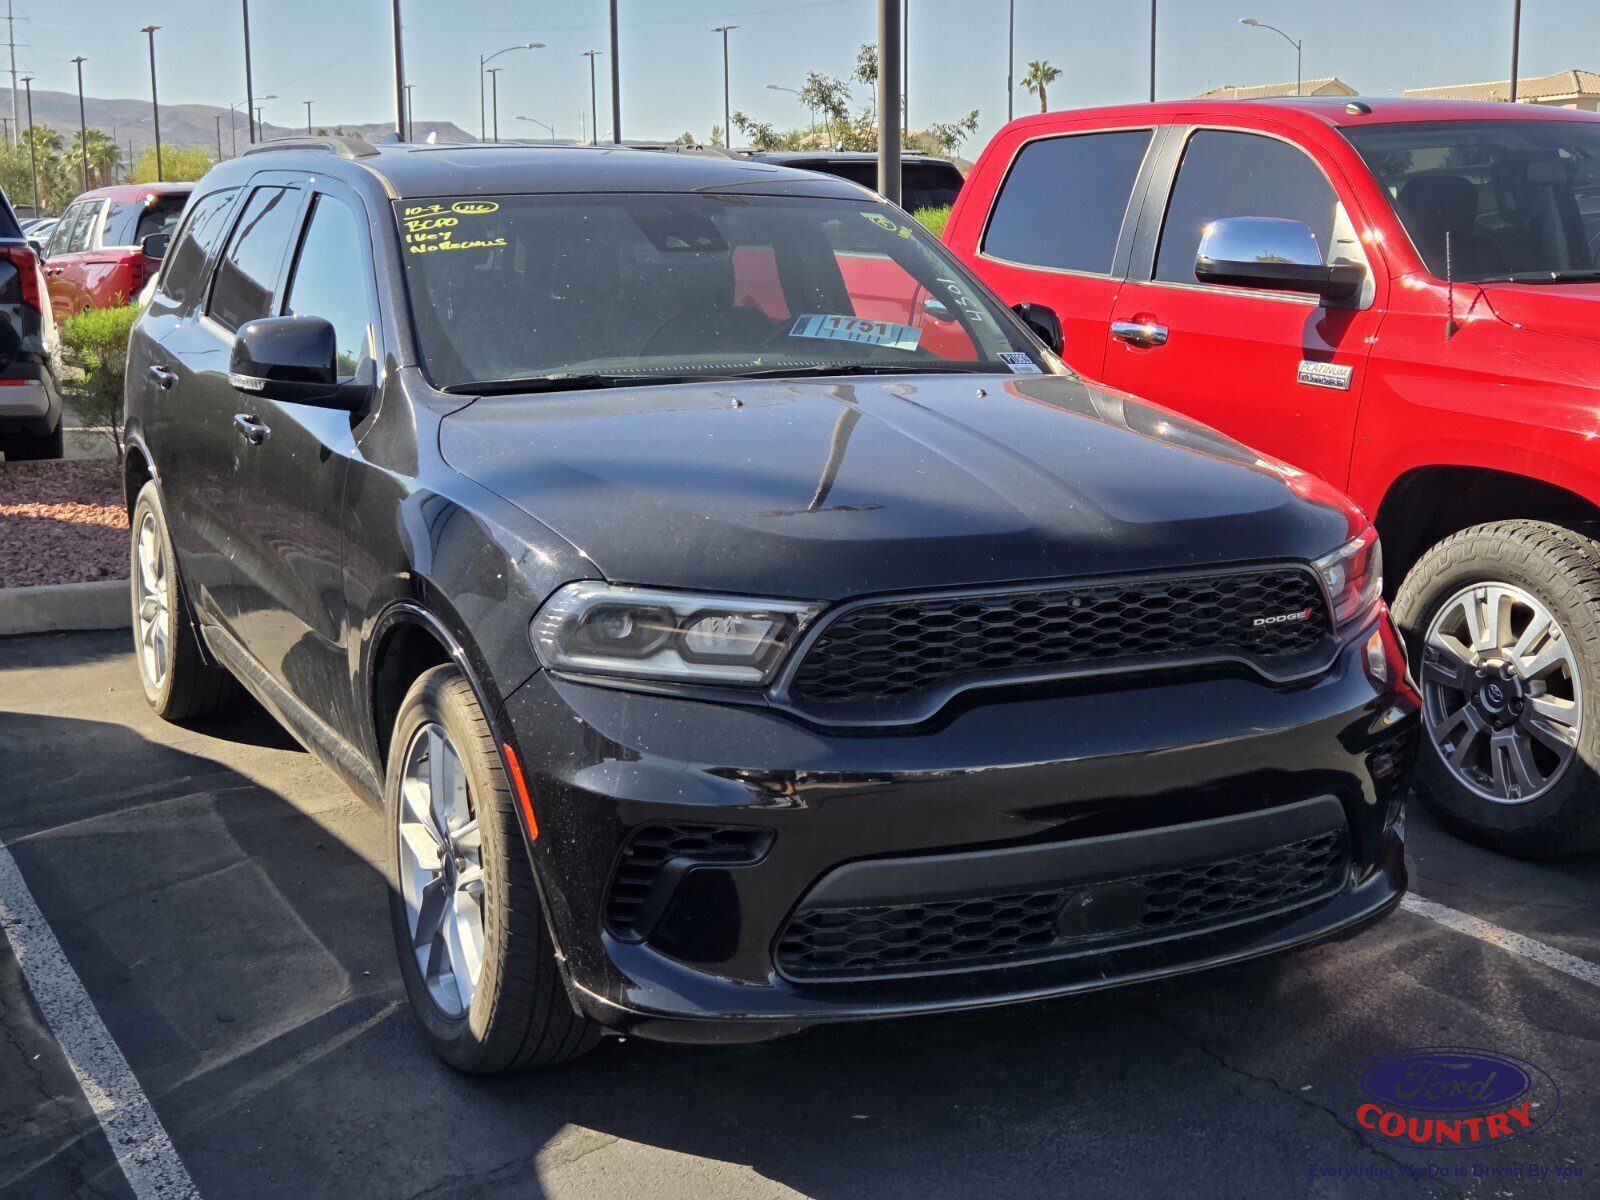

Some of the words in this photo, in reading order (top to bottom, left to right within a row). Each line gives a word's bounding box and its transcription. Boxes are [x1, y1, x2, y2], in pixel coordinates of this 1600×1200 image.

[828, 316, 887, 335] 1751
[1300, 362, 1348, 377] PLATINUM
[1253, 610, 1306, 626] DODGE
